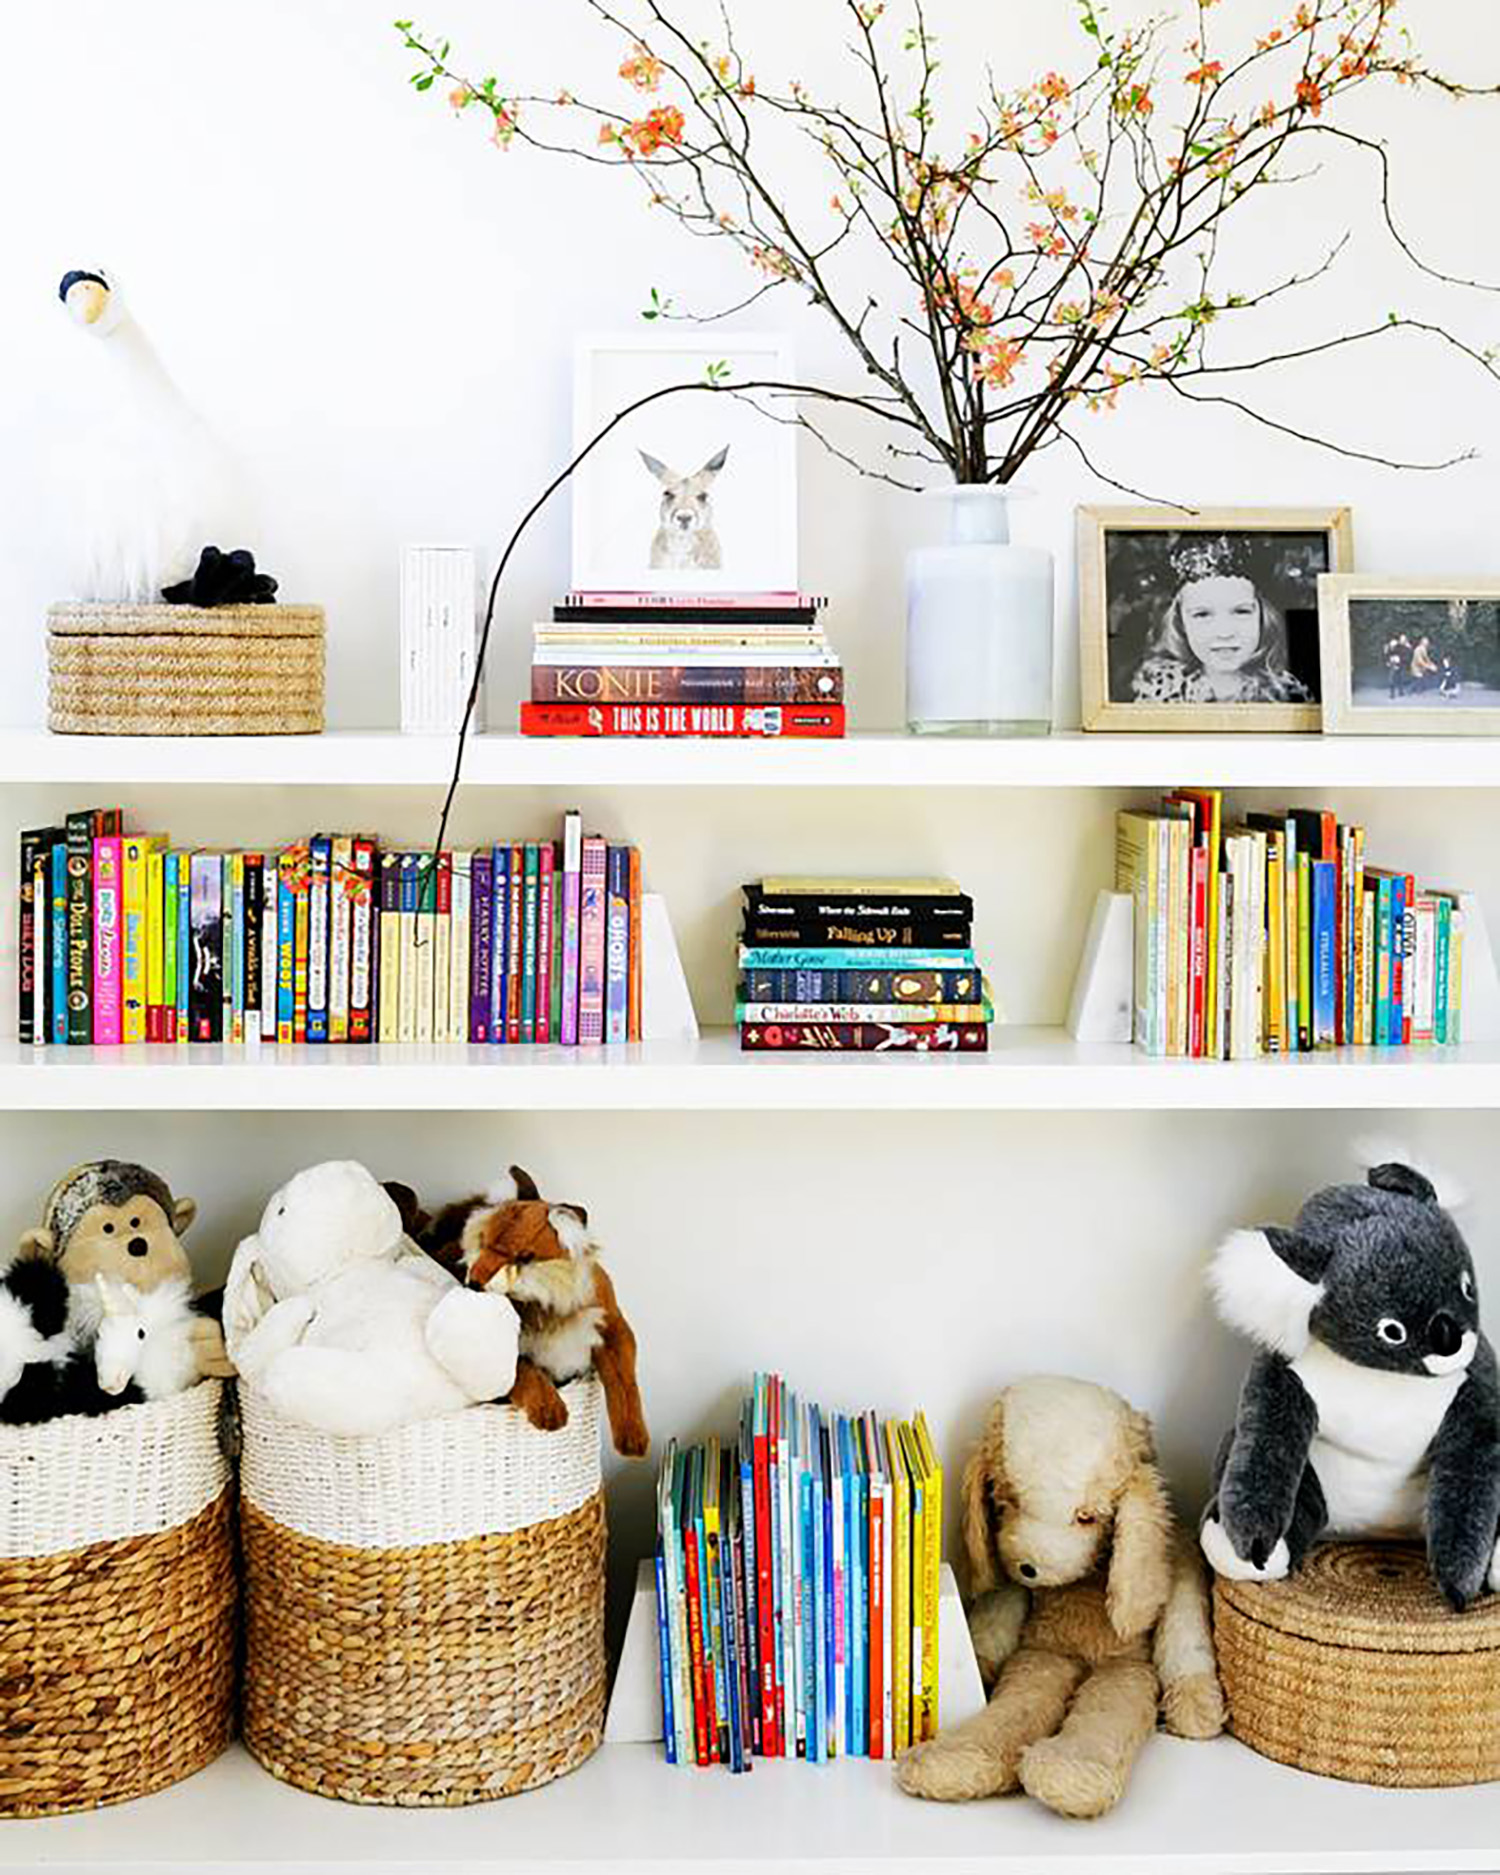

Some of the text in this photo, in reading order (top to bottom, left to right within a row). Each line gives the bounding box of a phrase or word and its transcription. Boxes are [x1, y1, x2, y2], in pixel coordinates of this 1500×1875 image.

[613, 707, 734, 731] THIS IS THE WORLD
[69, 902, 88, 937] DOLL
[609, 915, 626, 982] GHOSTS
[827, 925, 876, 945] Falling
[69, 939, 88, 987] PEOPLE
[760, 1006, 860, 1021] Charlotte's Web
